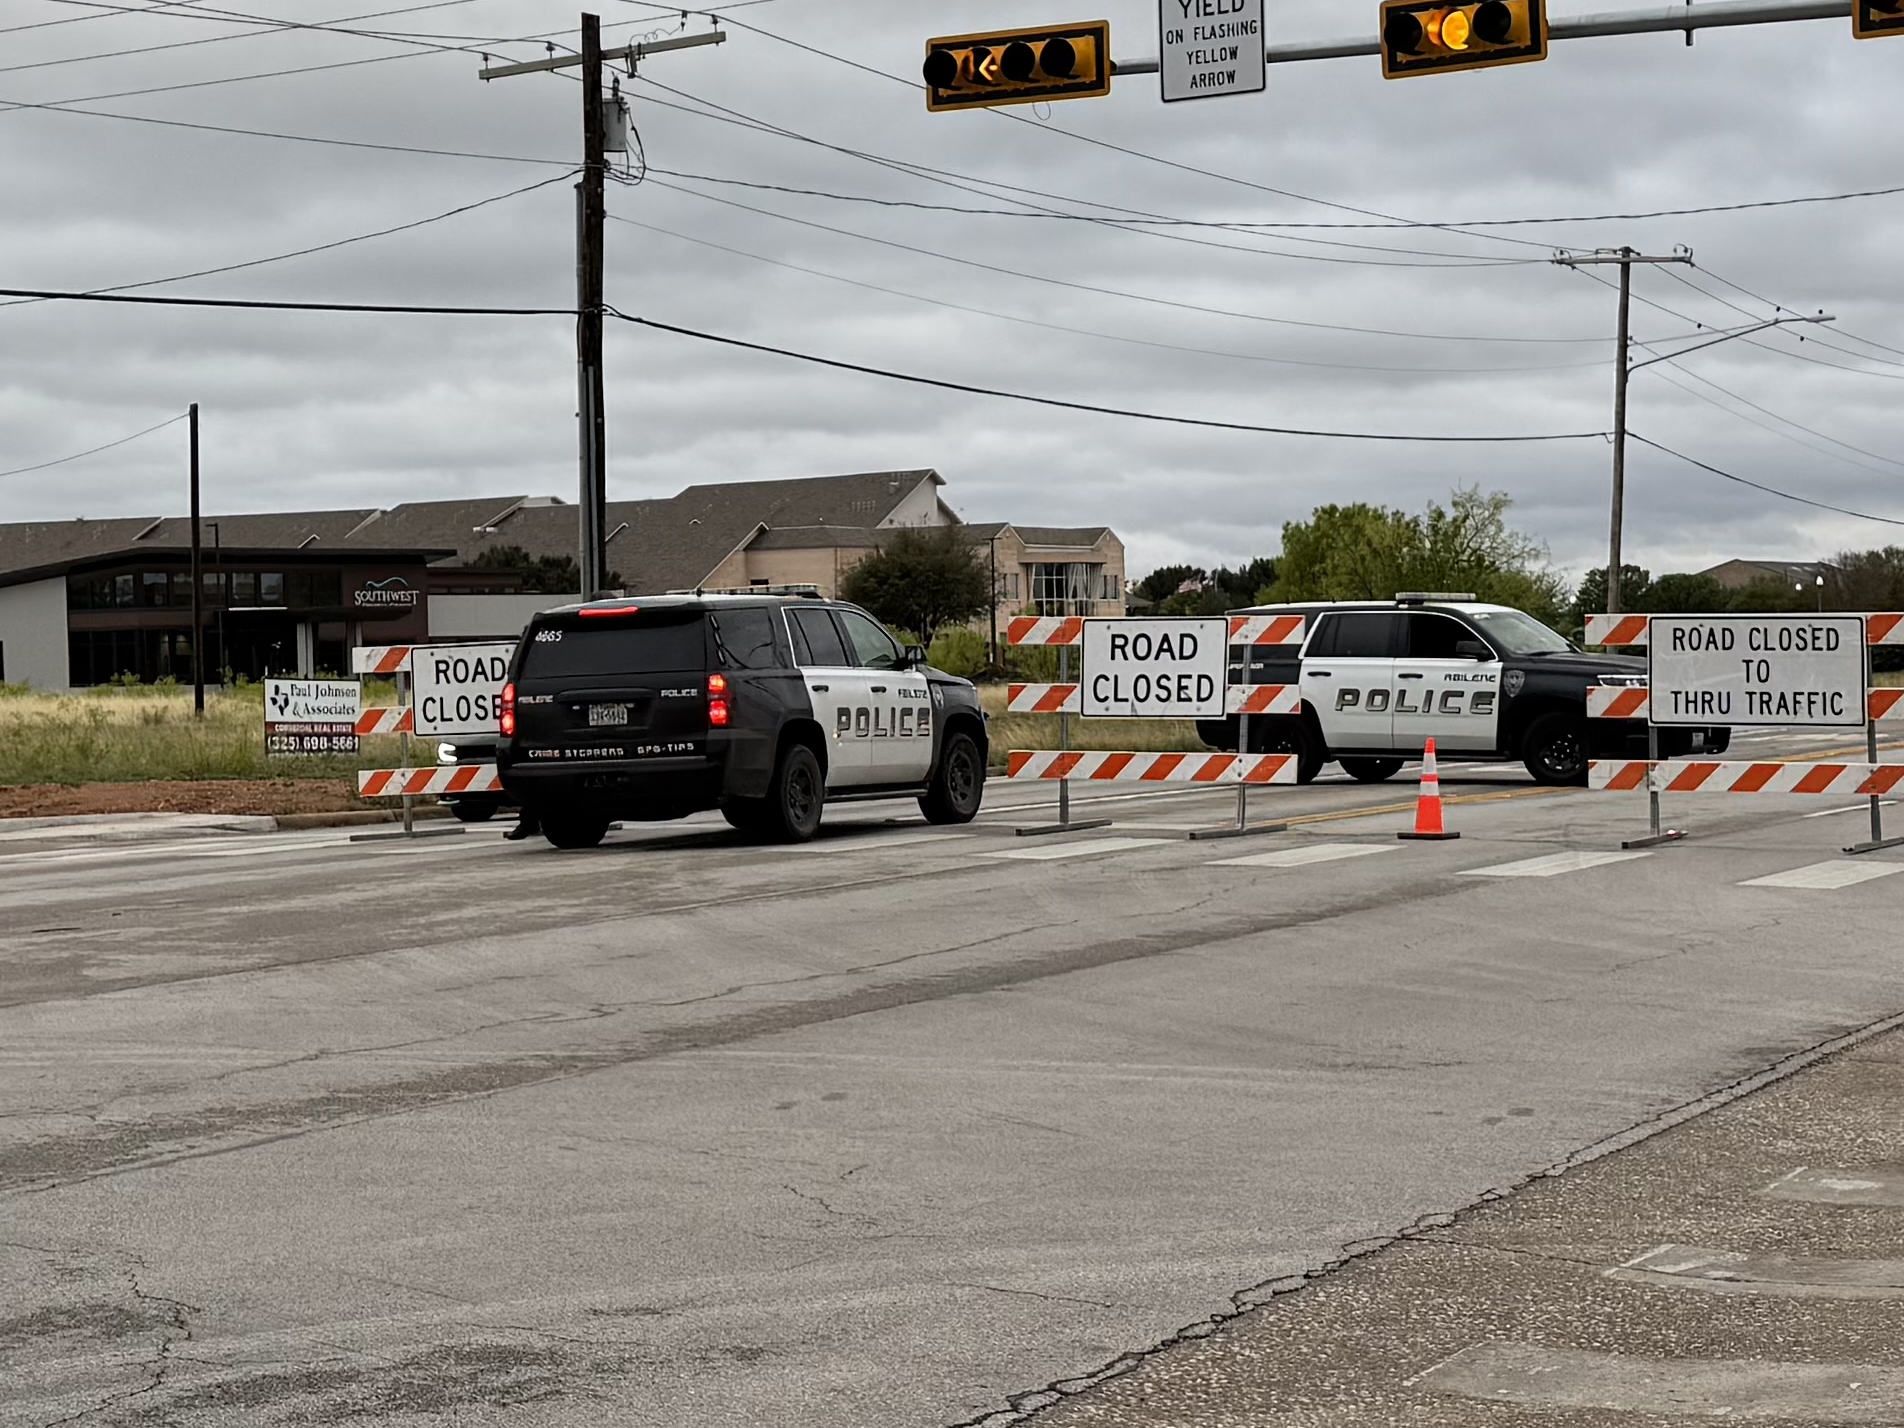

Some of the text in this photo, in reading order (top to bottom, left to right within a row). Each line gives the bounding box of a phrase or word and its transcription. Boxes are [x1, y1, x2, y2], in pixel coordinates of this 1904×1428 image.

[1166, 20, 1257, 45] ON FLASHING
[1186, 46, 1239, 65] YELLOW
[1190, 70, 1236, 89] ARROW
[354, 590, 420, 606] SOUTHWEST
[1110, 633, 1199, 661] ROAD
[1672, 627, 1840, 651] ROAD CLOSED
[434, 657, 507, 685] ROAD
[1742, 659, 1770, 684] TO
[290, 683, 357, 700] Paul Johnson
[1092, 673, 1214, 703] CLOSED
[303, 702, 356, 715] Associates
[422, 694, 502, 723] CLOSE
[1335, 688, 1496, 715] POLICE
[1670, 691, 1844, 717] THRU TRAFFIC
[836, 706, 930, 737] POLICE
